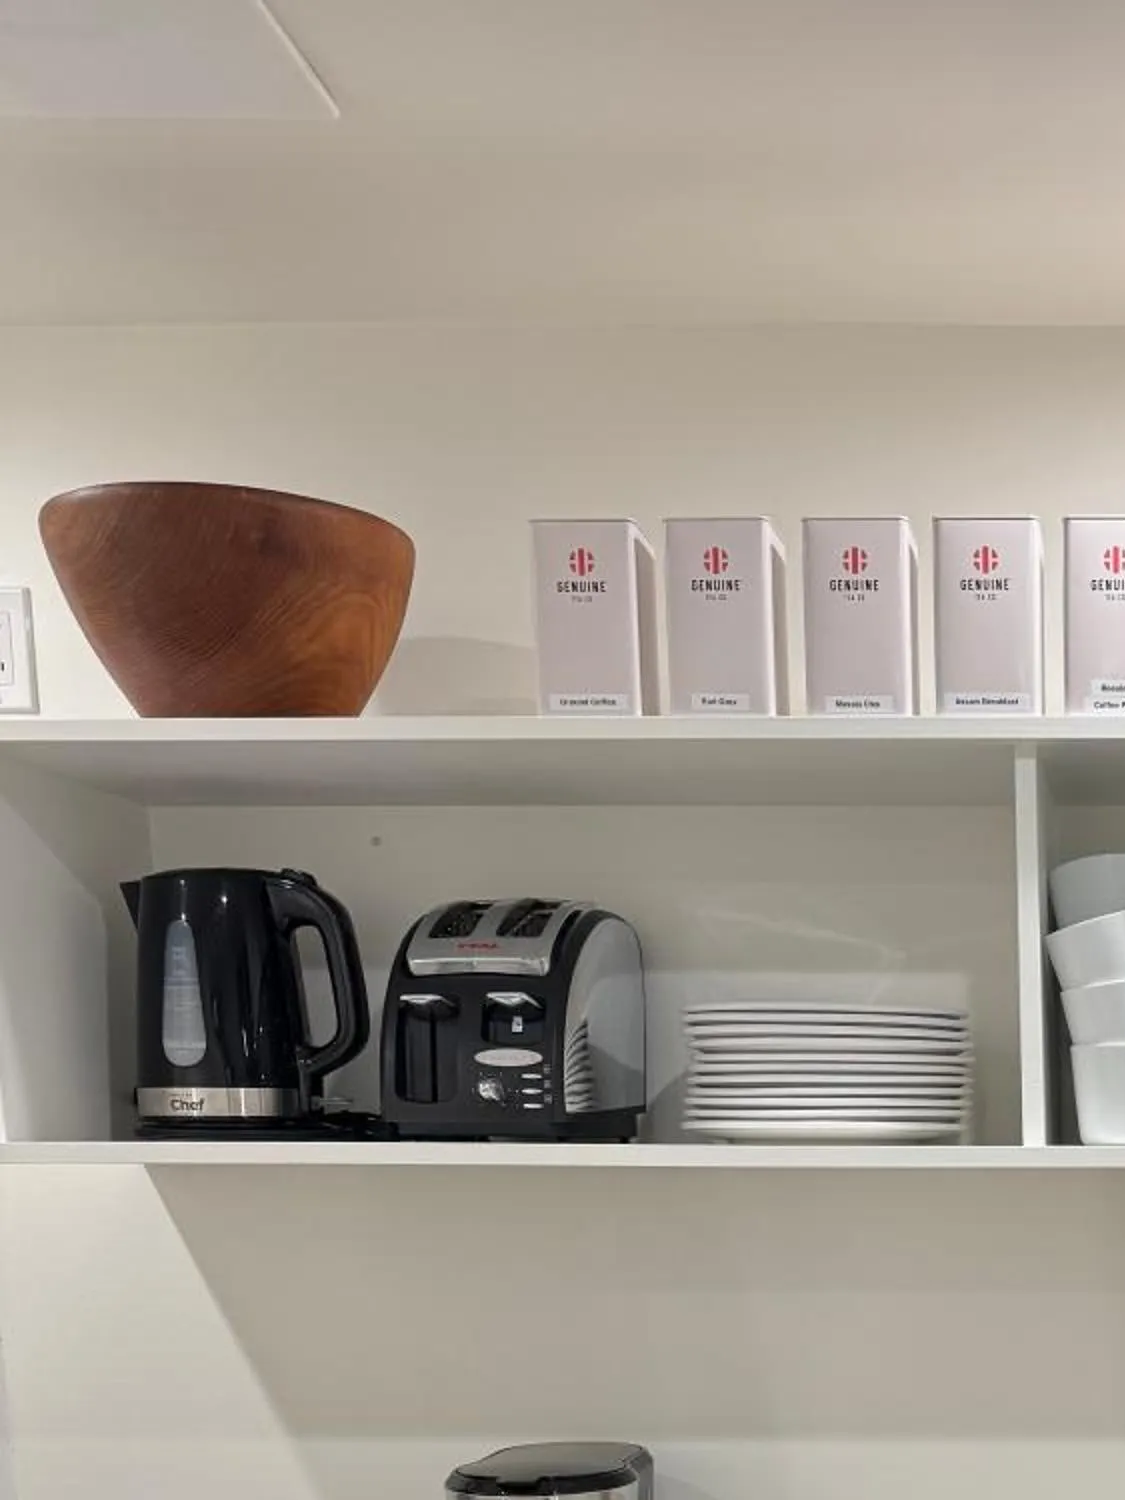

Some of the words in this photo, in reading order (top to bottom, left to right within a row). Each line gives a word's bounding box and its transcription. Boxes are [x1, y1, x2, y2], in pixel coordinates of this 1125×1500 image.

[557, 581, 606, 593] GENUINE
[691, 579, 741, 592] GENUINE
[829, 579, 879, 591] GENUINE
[960, 579, 1009, 591] GENUINE
[170, 1098, 205, 1112] Chef
